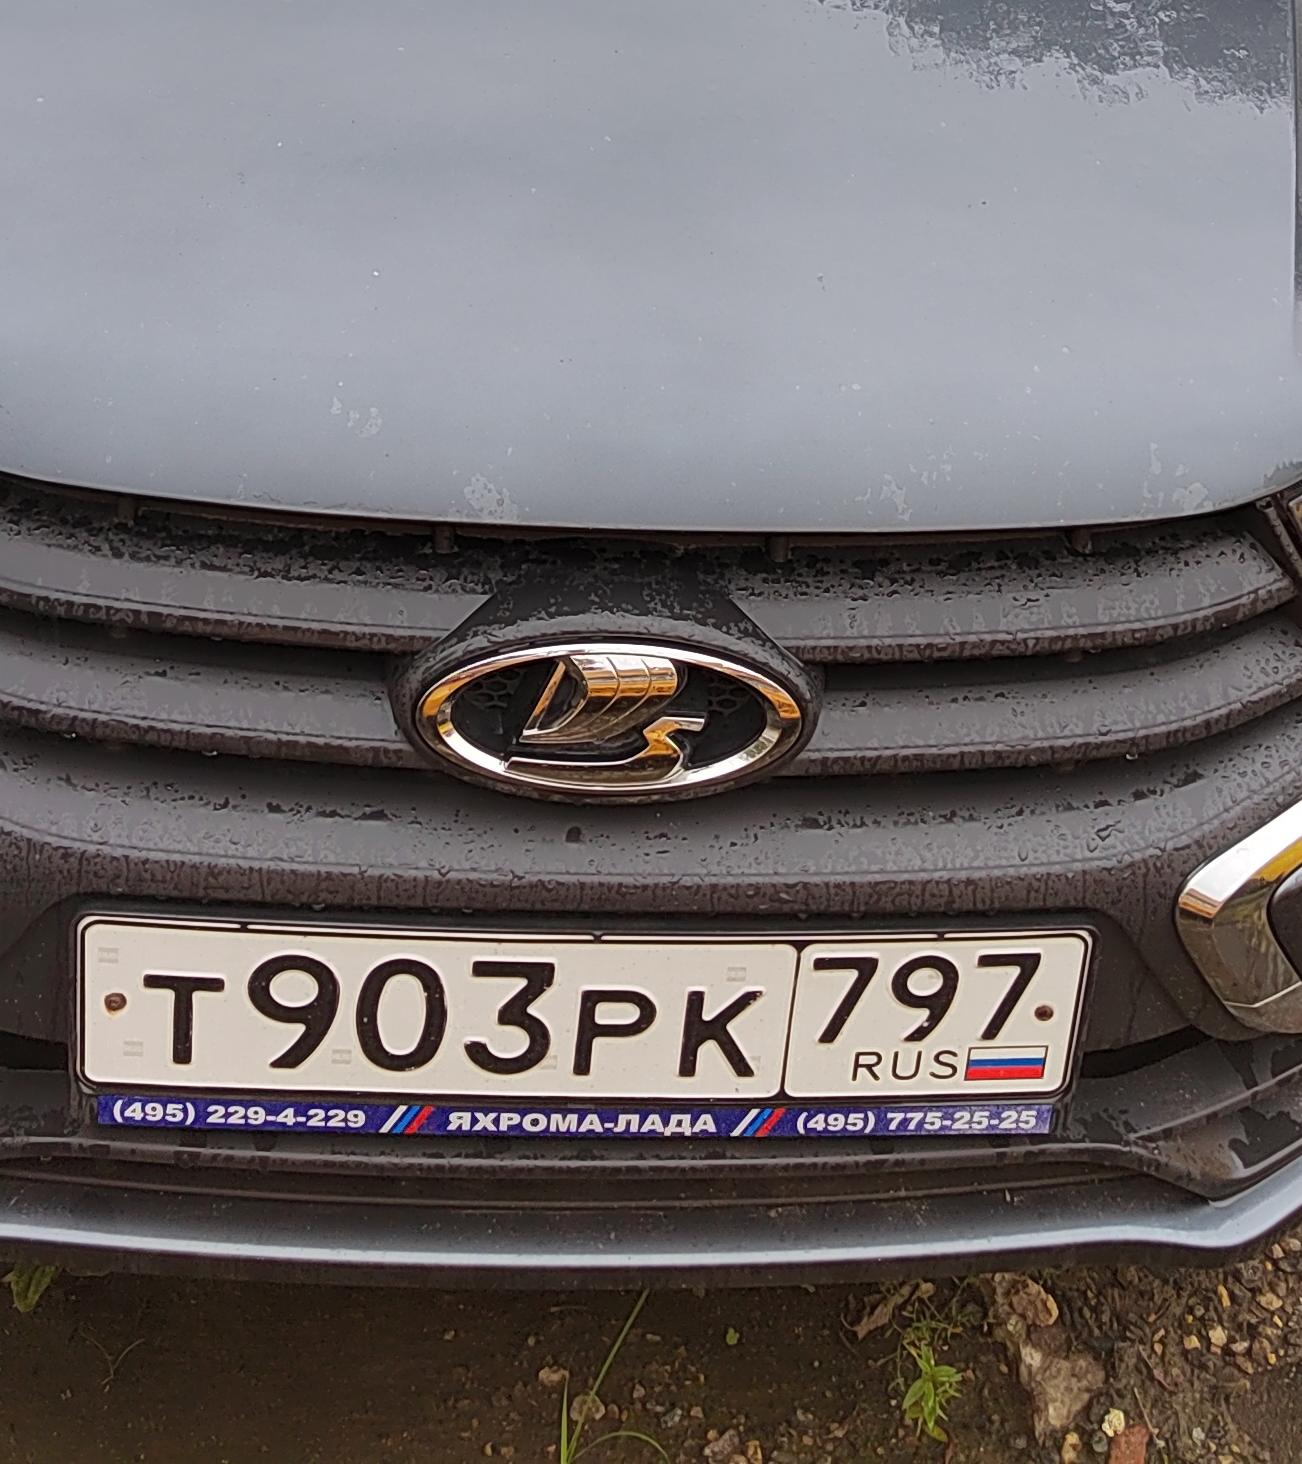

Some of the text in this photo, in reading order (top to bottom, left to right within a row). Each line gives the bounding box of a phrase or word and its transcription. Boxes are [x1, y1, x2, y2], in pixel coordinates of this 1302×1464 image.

[142, 953, 765, 1078] Т903РК
[812, 952, 1042, 1044] 797
[851, 1049, 959, 1082] RUS
[112, 1100, 1038, 1136] (495) 229-4-229 ЯХРОМА-ЛАДА (495) 775-25-25
